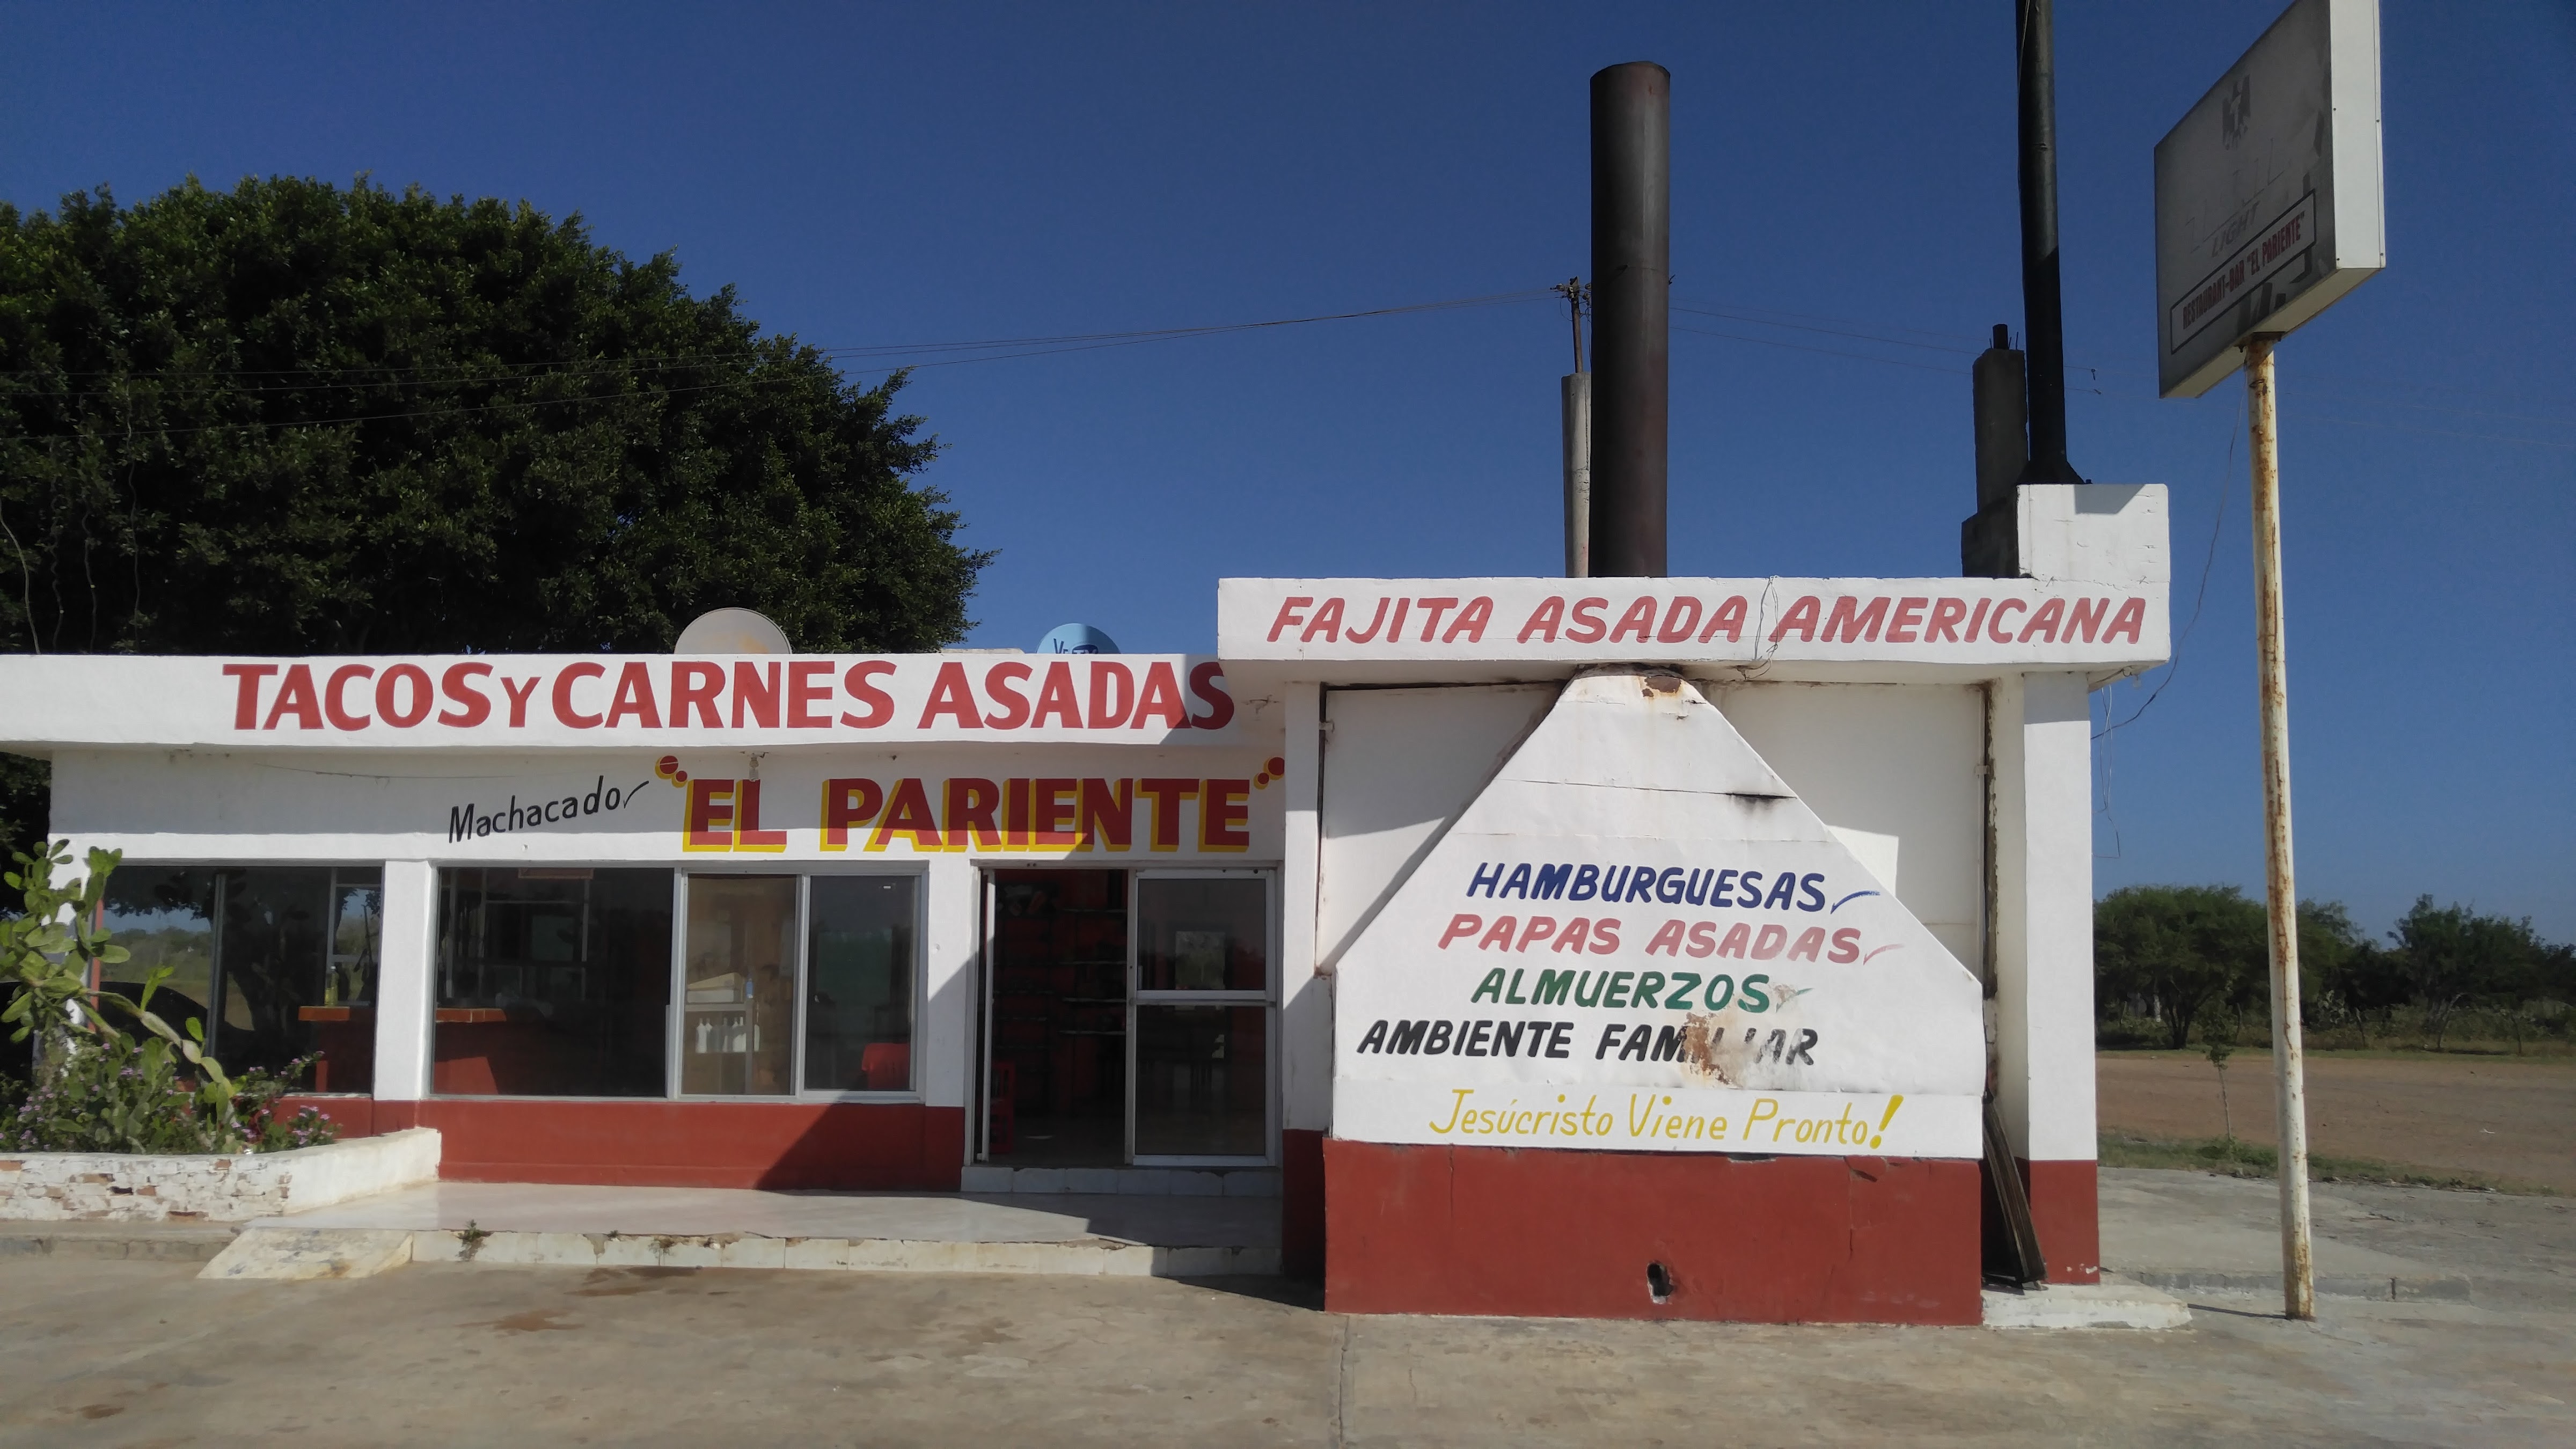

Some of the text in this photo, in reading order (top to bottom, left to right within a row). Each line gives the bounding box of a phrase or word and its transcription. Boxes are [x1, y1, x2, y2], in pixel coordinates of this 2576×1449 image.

[1267, 596, 2146, 644] FAJITA ASADA AMERICANA
[223, 660, 1234, 731] TACOS Y CARNES ASADAS
[448, 775, 622, 844] Machacado
[1466, 862, 1825, 912] HAMBURGUESAS
[1438, 913, 1861, 964] PAPAS ASADAS
[1470, 968, 1769, 1013] ALMUERZOS
[1356, 1020, 1818, 1065] AMBIENTE FAMAR
[1629, 1093, 1727, 1140] Viene
[1743, 1094, 1904, 1148] Pronto!
